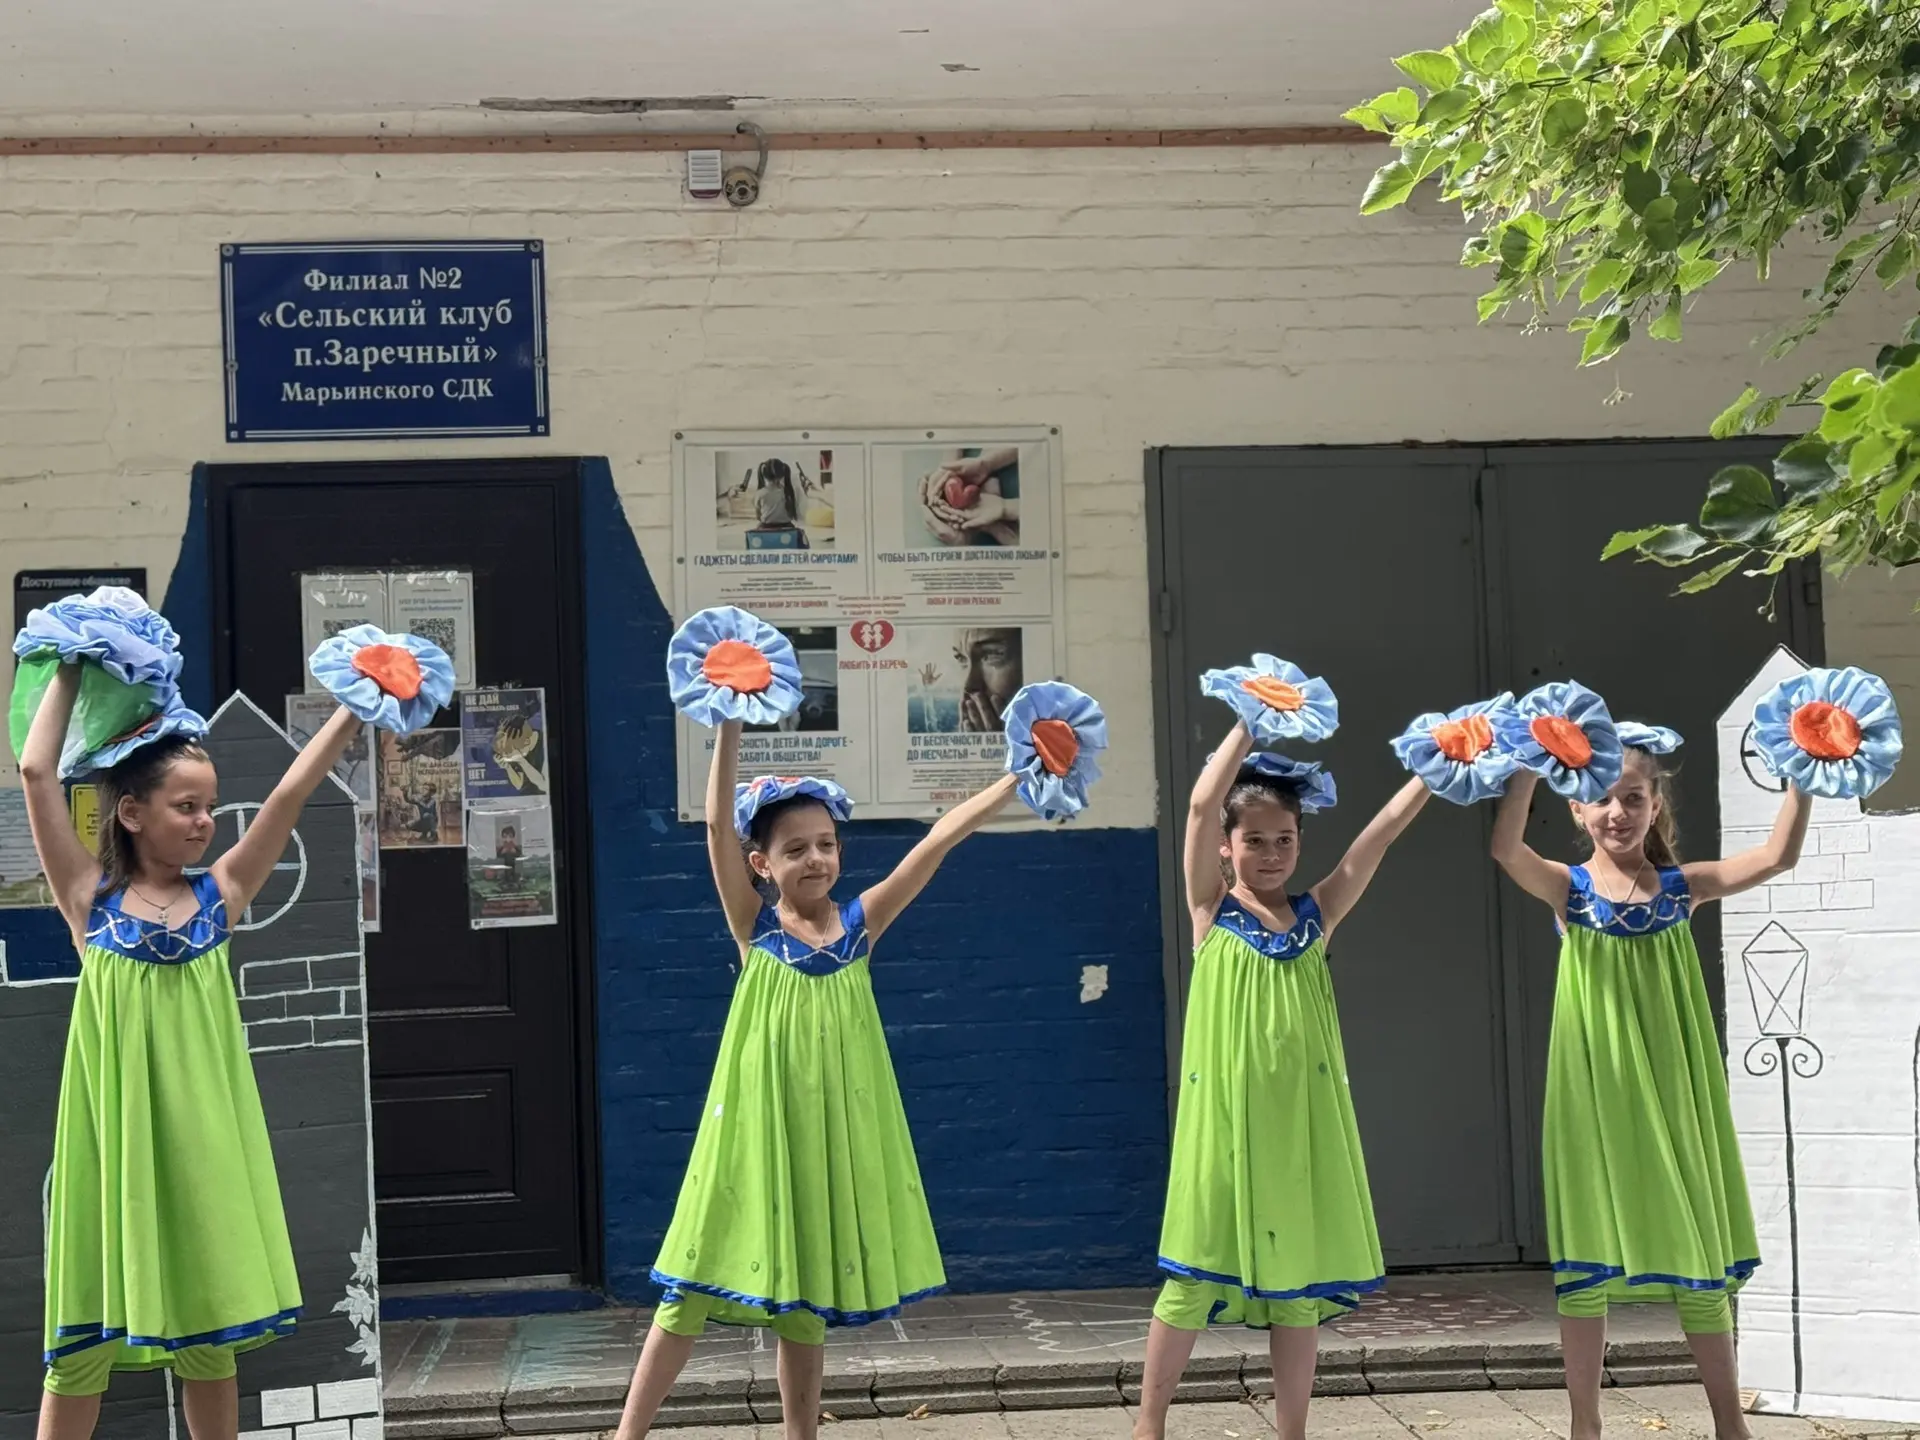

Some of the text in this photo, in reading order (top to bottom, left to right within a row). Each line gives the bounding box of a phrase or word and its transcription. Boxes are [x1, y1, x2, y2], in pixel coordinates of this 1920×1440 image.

[304, 267, 462, 291] Филиал №2
[258, 299, 513, 332] «Сельский клуб
[294, 337, 498, 372] п.Заречный»
[281, 378, 494, 406] Марьинского СДК
[694, 552, 859, 567] ГАДЖЕТЫ СДЕЛАЛИ ДЕТЕЙ СИРОТАМИ!
[877, 553, 906, 563] ЧТОБЫ
[907, 552, 930, 562] БЫТЬ
[931, 551, 963, 562] ГЕРОЕМ
[964, 551, 1014, 561] ДОСТАТОЧНО
[838, 659, 909, 670] ЛЮБИТЬ И БЕРЕЧЬ
[465, 692, 499, 706] НЕ ДАЙ
[704, 737, 770, 750] БЕСНОСТЬ
[772, 736, 800, 749] ДЕТЕЙ
[801, 737, 814, 748] НА
[815, 736, 847, 748] ДОРОГЕ
[911, 736, 922, 747] ОТ
[923, 735, 982, 746] БЕСПЕЧНОСТИ
[985, 735, 998, 745] НА
[738, 750, 822, 763] ЗАБОТА ОБЩЕСТВА!
[907, 749, 919, 761] ДО
[921, 749, 968, 760] НЕСЧАСТЬЯ
[980, 748, 1004, 759] ОДИН
